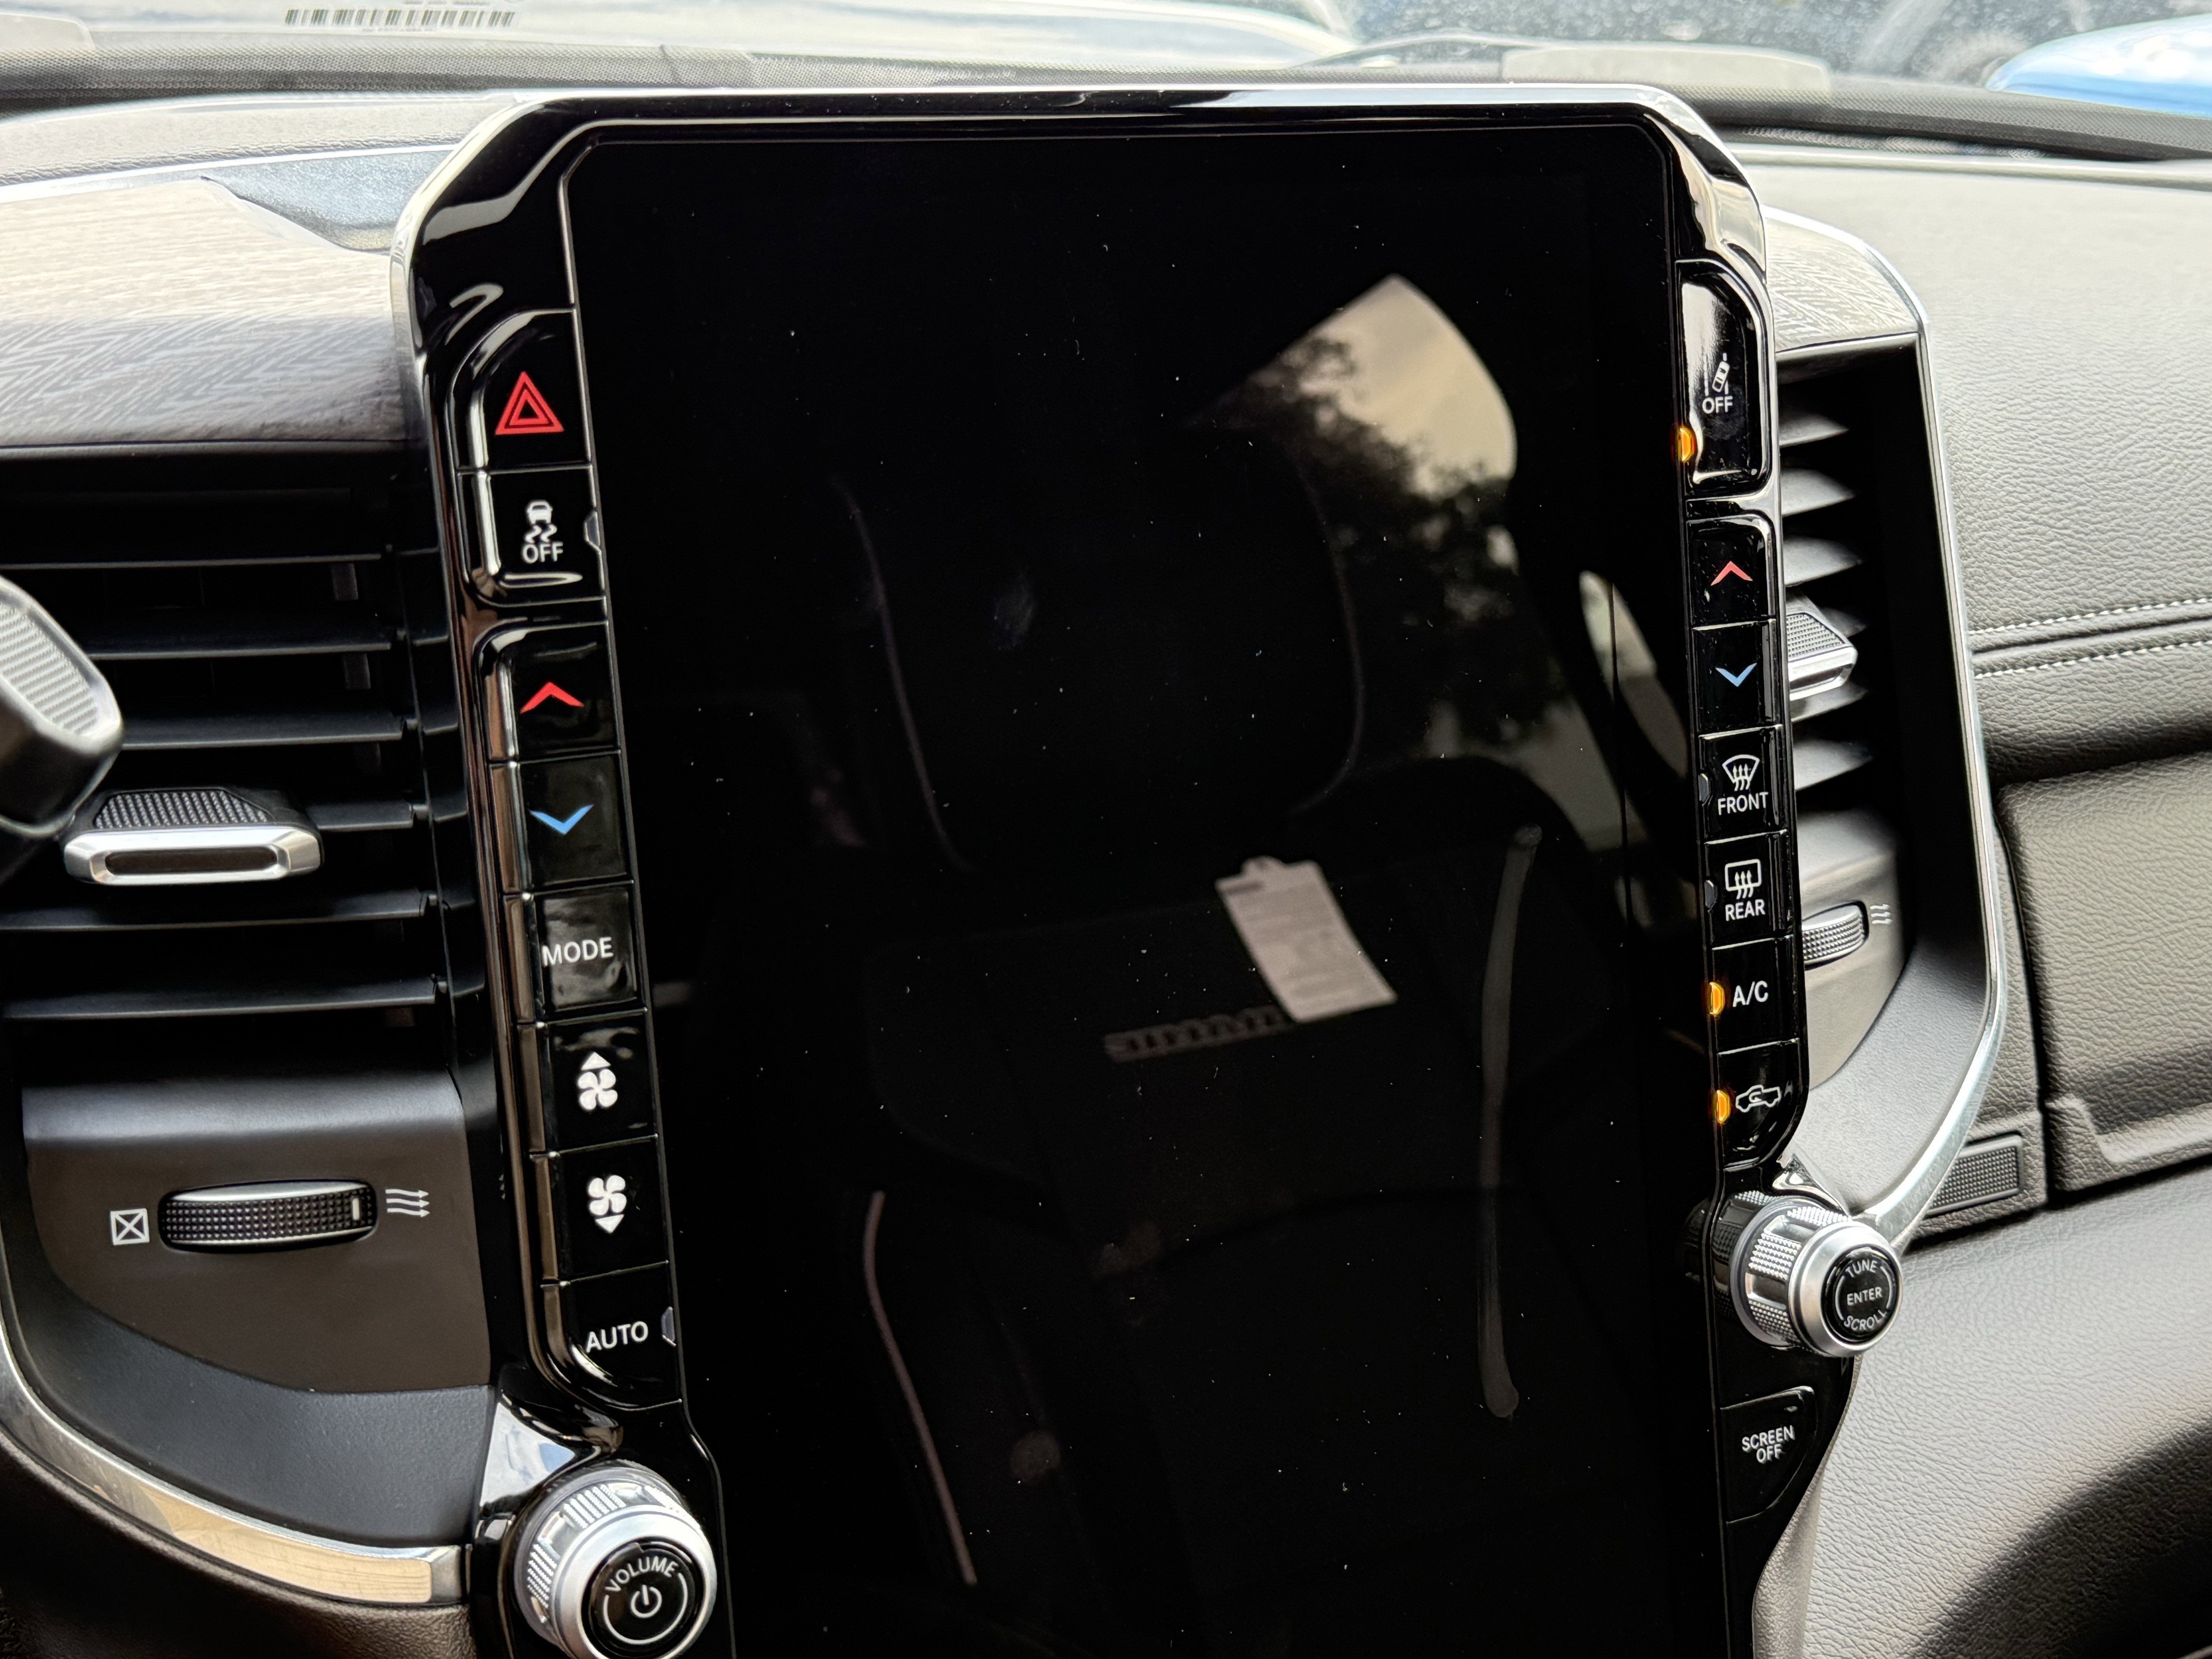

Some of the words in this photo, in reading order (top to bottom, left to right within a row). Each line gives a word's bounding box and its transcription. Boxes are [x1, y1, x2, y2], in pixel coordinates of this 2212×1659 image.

[1702, 396, 1733, 414] OFF
[522, 541, 563, 564] OFF
[1718, 792, 1768, 816] FRONT
[1725, 900, 1765, 921] REAR
[542, 936, 613, 967] MODE
[1732, 981, 1769, 1007] A/C
[1846, 1259, 1878, 1278] TUNE
[1847, 1287, 1883, 1306] ENTER
[1844, 1310, 1887, 1331] SCROLL
[586, 1321, 649, 1353] AUTO
[1742, 1425, 1795, 1453] SCREEN
[1757, 1444, 1783, 1464] OFF
[605, 1556, 679, 1592] VOLUME
